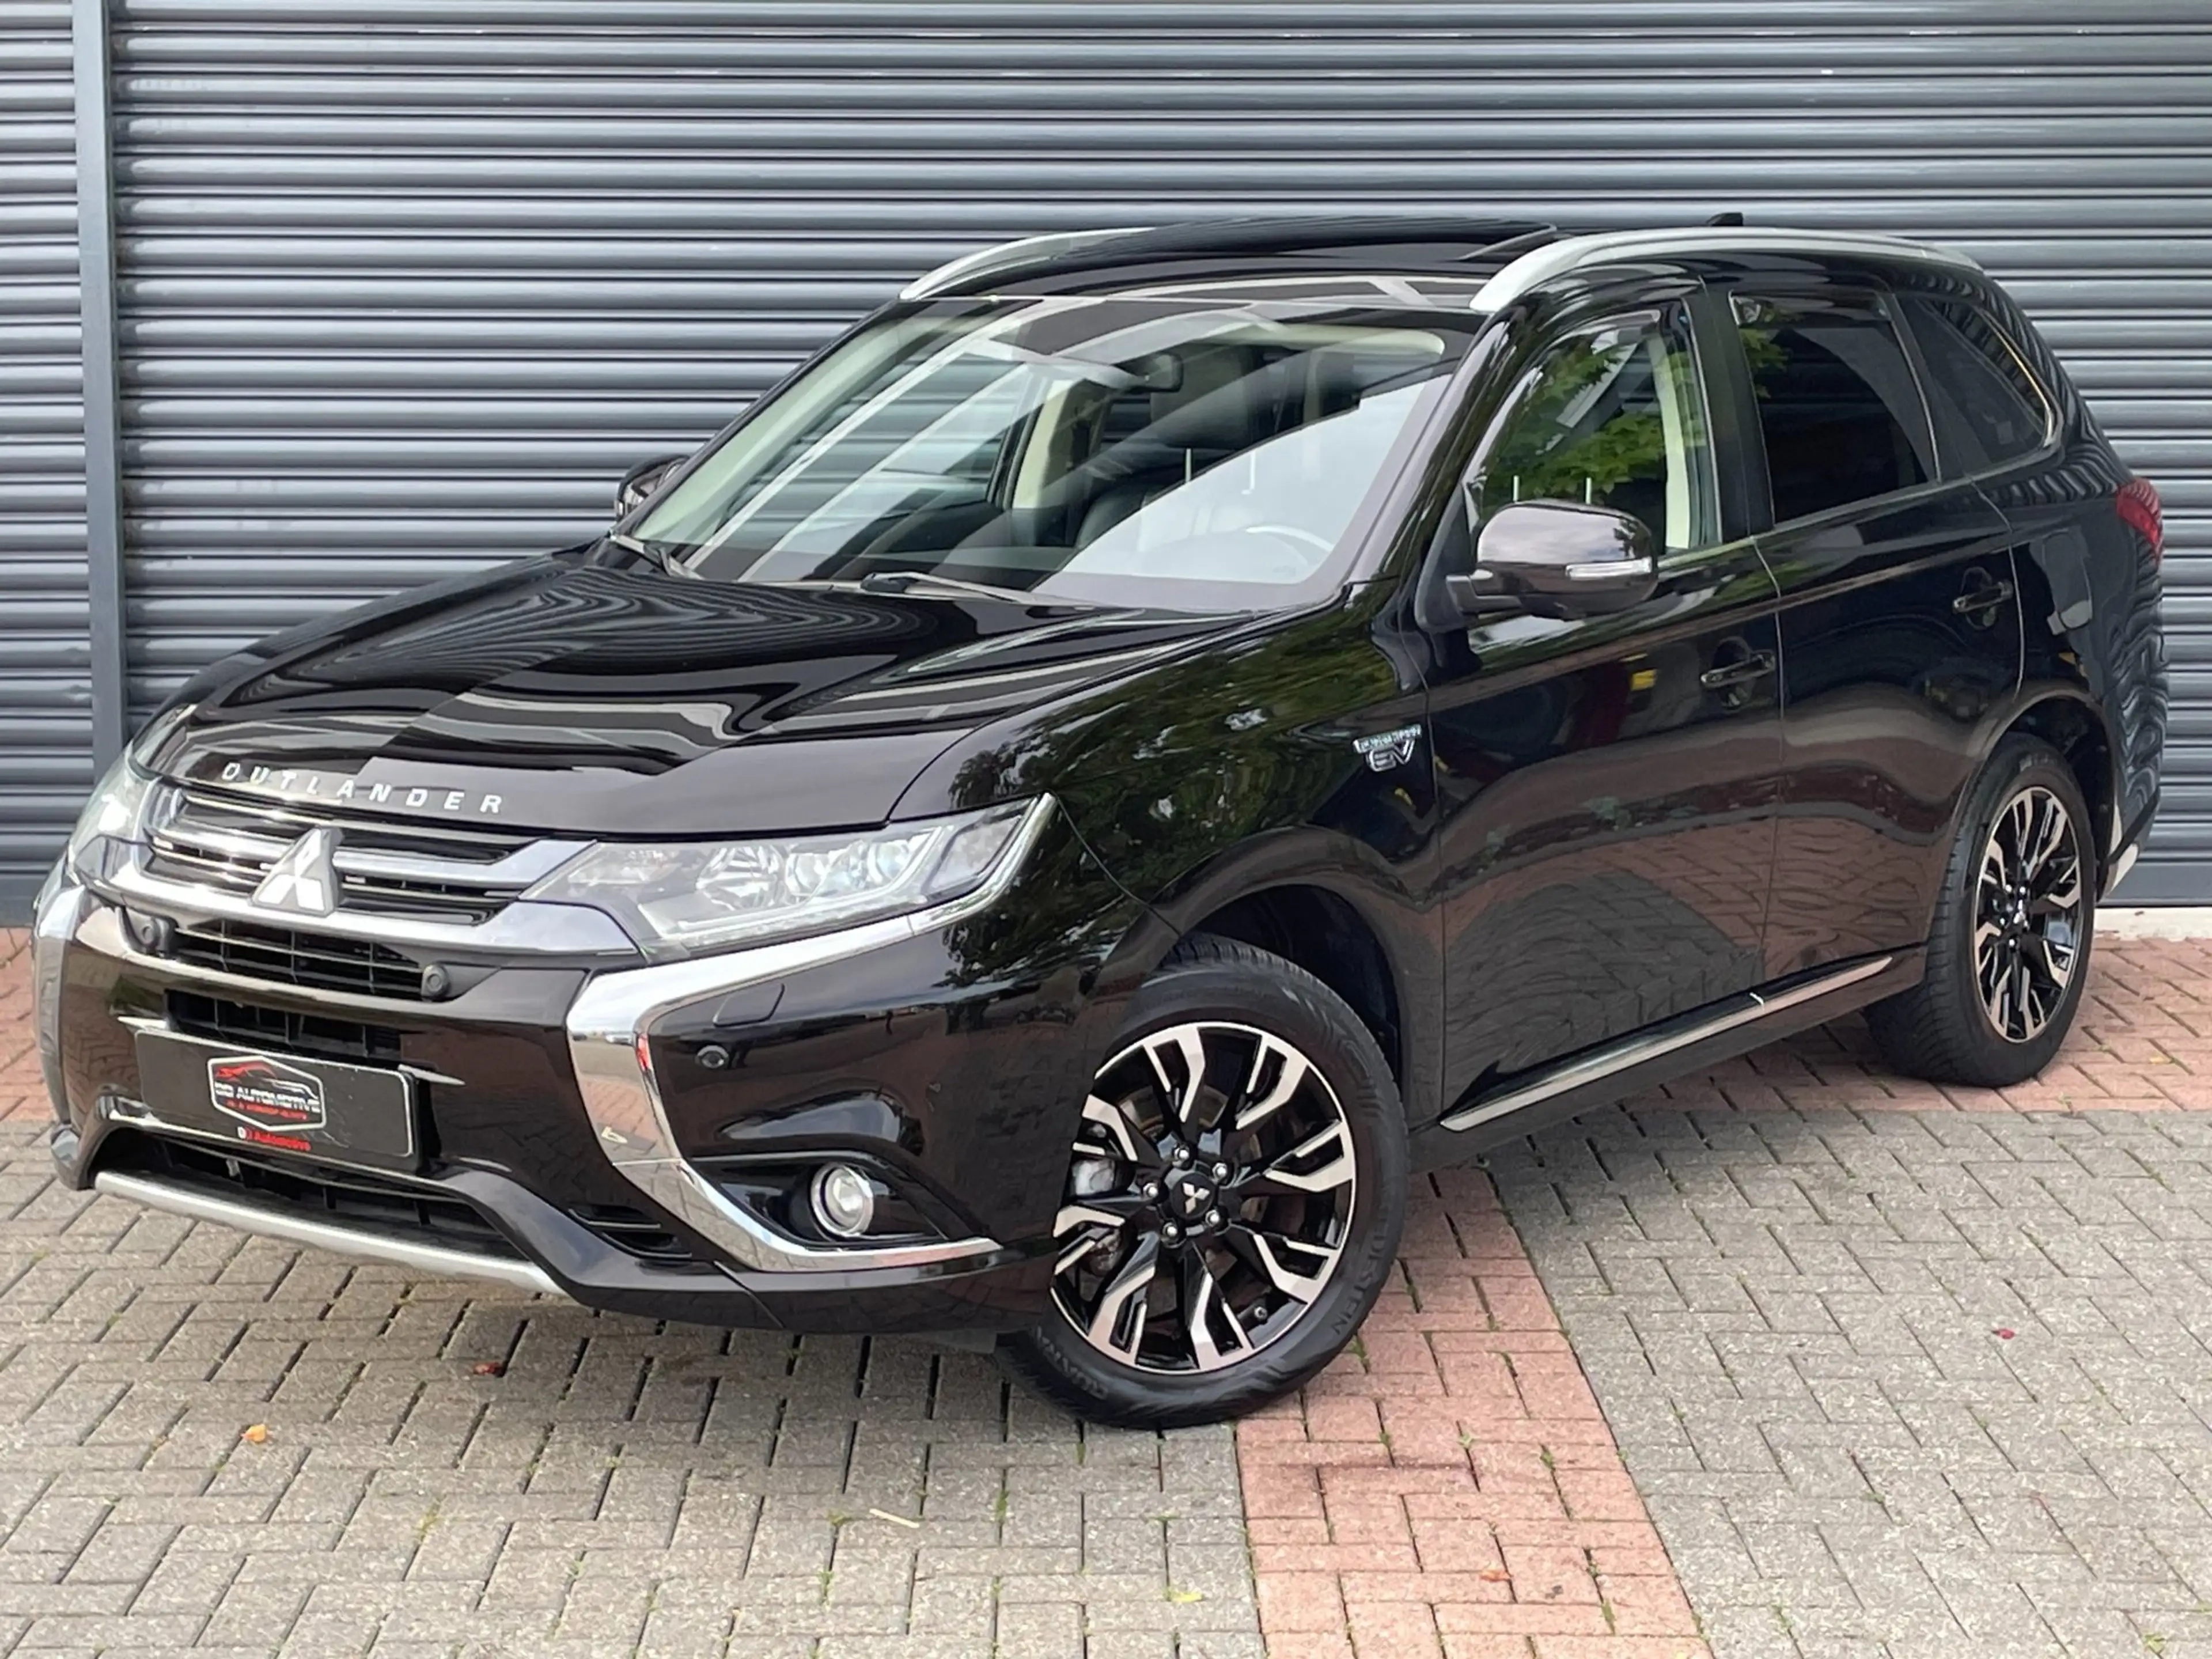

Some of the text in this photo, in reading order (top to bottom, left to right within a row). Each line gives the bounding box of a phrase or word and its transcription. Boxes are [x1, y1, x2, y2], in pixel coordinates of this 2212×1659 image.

[1366, 739, 1415, 772] EV
[221, 762, 503, 813] OUTLANDER
[236, 1085, 321, 1113] AUTOMOTIVE
